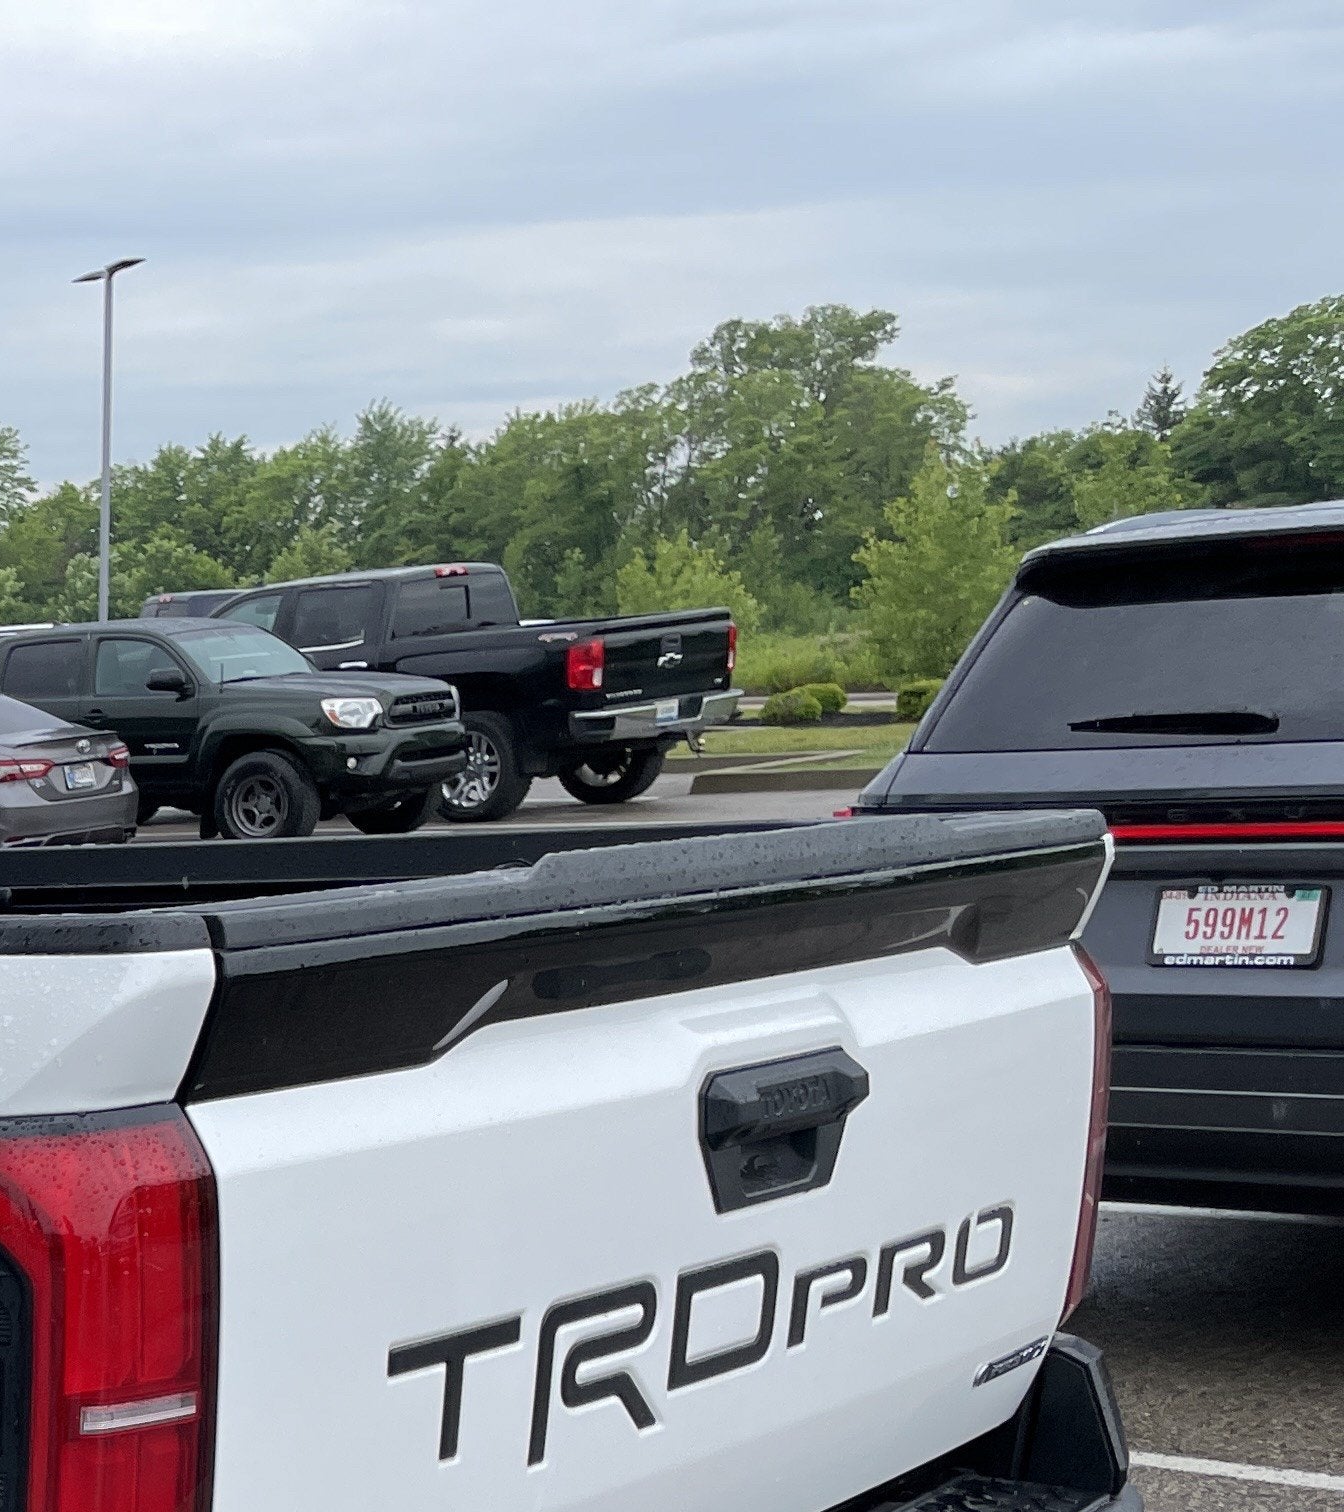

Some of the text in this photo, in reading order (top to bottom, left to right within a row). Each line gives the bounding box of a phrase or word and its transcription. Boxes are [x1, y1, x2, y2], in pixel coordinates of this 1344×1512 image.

[1197, 884, 1286, 894] ED MARTIN
[1184, 906, 1290, 941] 599M12
[1163, 953, 1295, 966] edmartin.com
